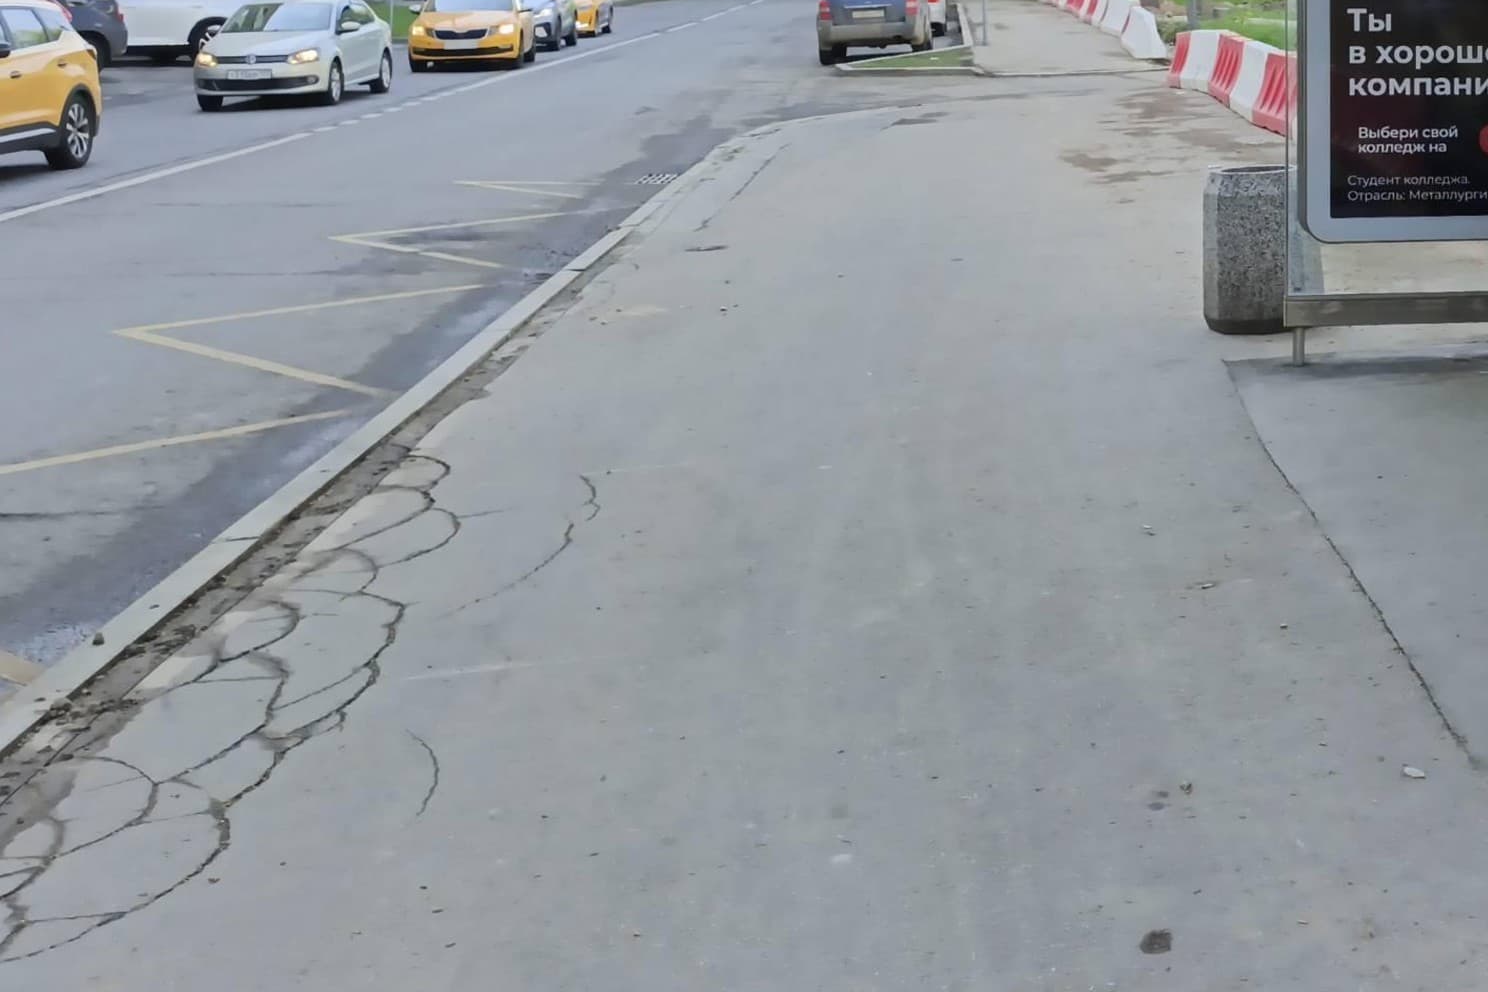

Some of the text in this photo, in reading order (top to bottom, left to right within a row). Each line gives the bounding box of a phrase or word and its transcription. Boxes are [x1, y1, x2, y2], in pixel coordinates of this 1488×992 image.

[1347, 8, 1393, 32] Ты
[1349, 45, 1367, 64] в
[1357, 125, 1459, 141] Выбери свой
[1357, 141, 1448, 156] колледж на
[1347, 175, 1401, 188] Студент
[1347, 189, 1406, 203] Отрасль:
